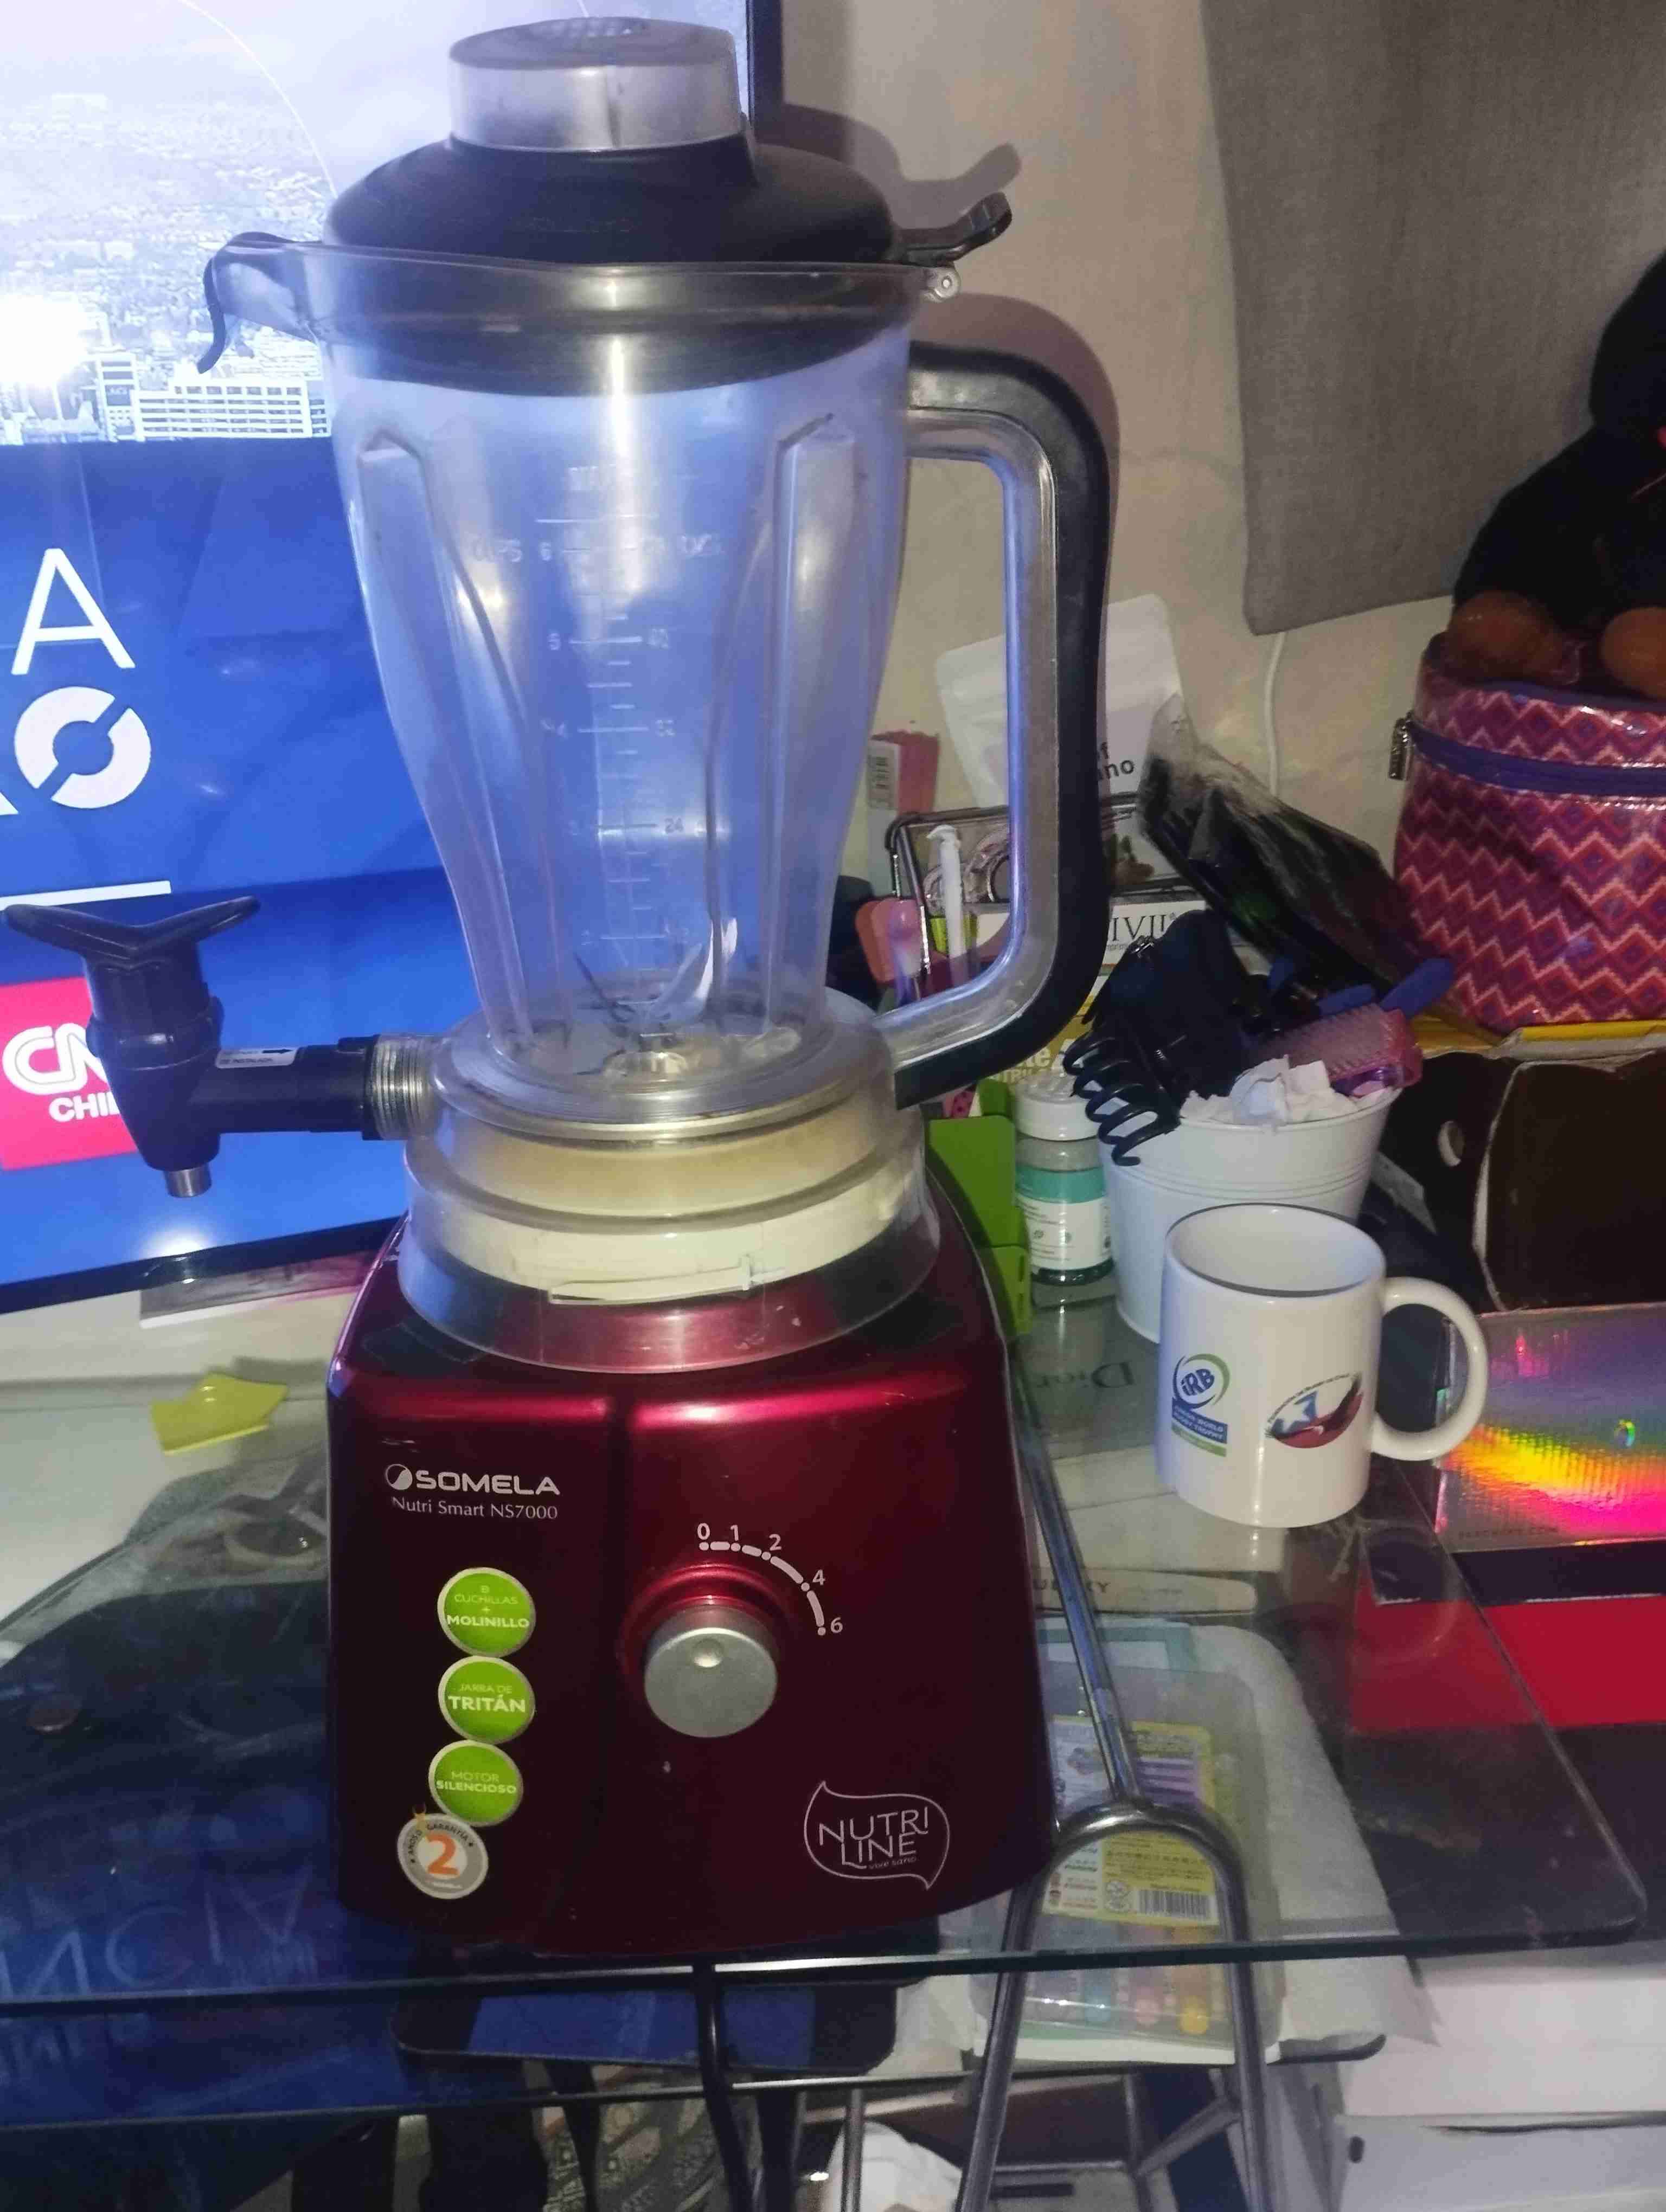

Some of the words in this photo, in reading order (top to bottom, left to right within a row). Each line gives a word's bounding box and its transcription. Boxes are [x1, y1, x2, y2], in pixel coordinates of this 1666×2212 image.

[2, 1023, 111, 1095] CN
[415, 1469, 560, 1495] SOMELA
[391, 1496, 432, 1514] Nutri
[438, 1500, 484, 1517] Smart
[491, 1503, 558, 1520] NS7000
[697, 1522, 710, 1540] 0
[730, 1525, 740, 1541] 1
[769, 1534, 782, 1551] 2
[812, 1570, 826, 1585] 4
[454, 1593, 518, 1605] CUCHILLAS
[447, 1615, 530, 1628] MOLINILLO
[830, 1617, 843, 1634] 6
[459, 1683, 494, 1693] JARRA
[497, 1685, 512, 1694] DE
[448, 1694, 526, 1713] TRITÁN
[451, 1771, 499, 1783] MOTOR
[436, 1780, 517, 1794] SILENCIOSO
[818, 1806, 929, 1847] NUTRI
[427, 1832, 460, 1875] 2
[841, 1832, 917, 1869] LINE
